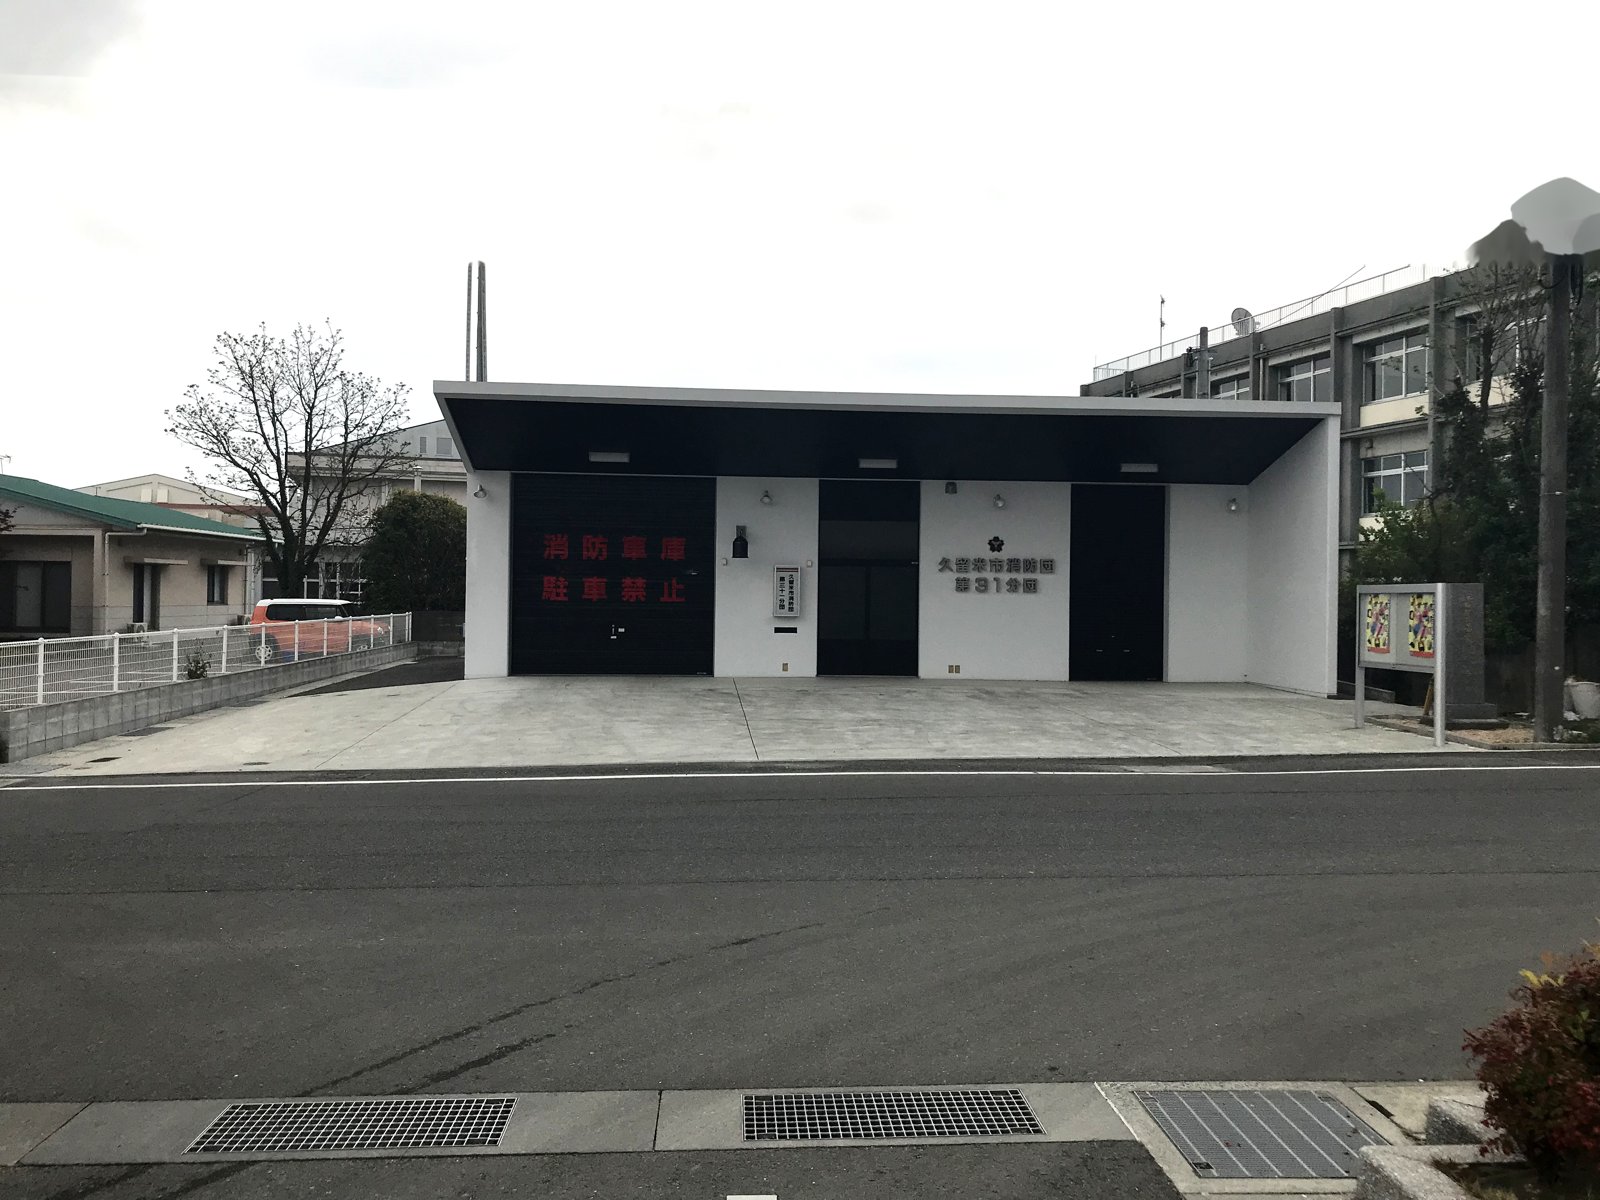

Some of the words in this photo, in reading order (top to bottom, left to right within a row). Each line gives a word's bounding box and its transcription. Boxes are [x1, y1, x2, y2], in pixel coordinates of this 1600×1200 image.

[543, 533, 686, 561] 消防車庫
[938, 557, 1055, 574] 久留米市消防団
[541, 575, 686, 603] 駐車禁止
